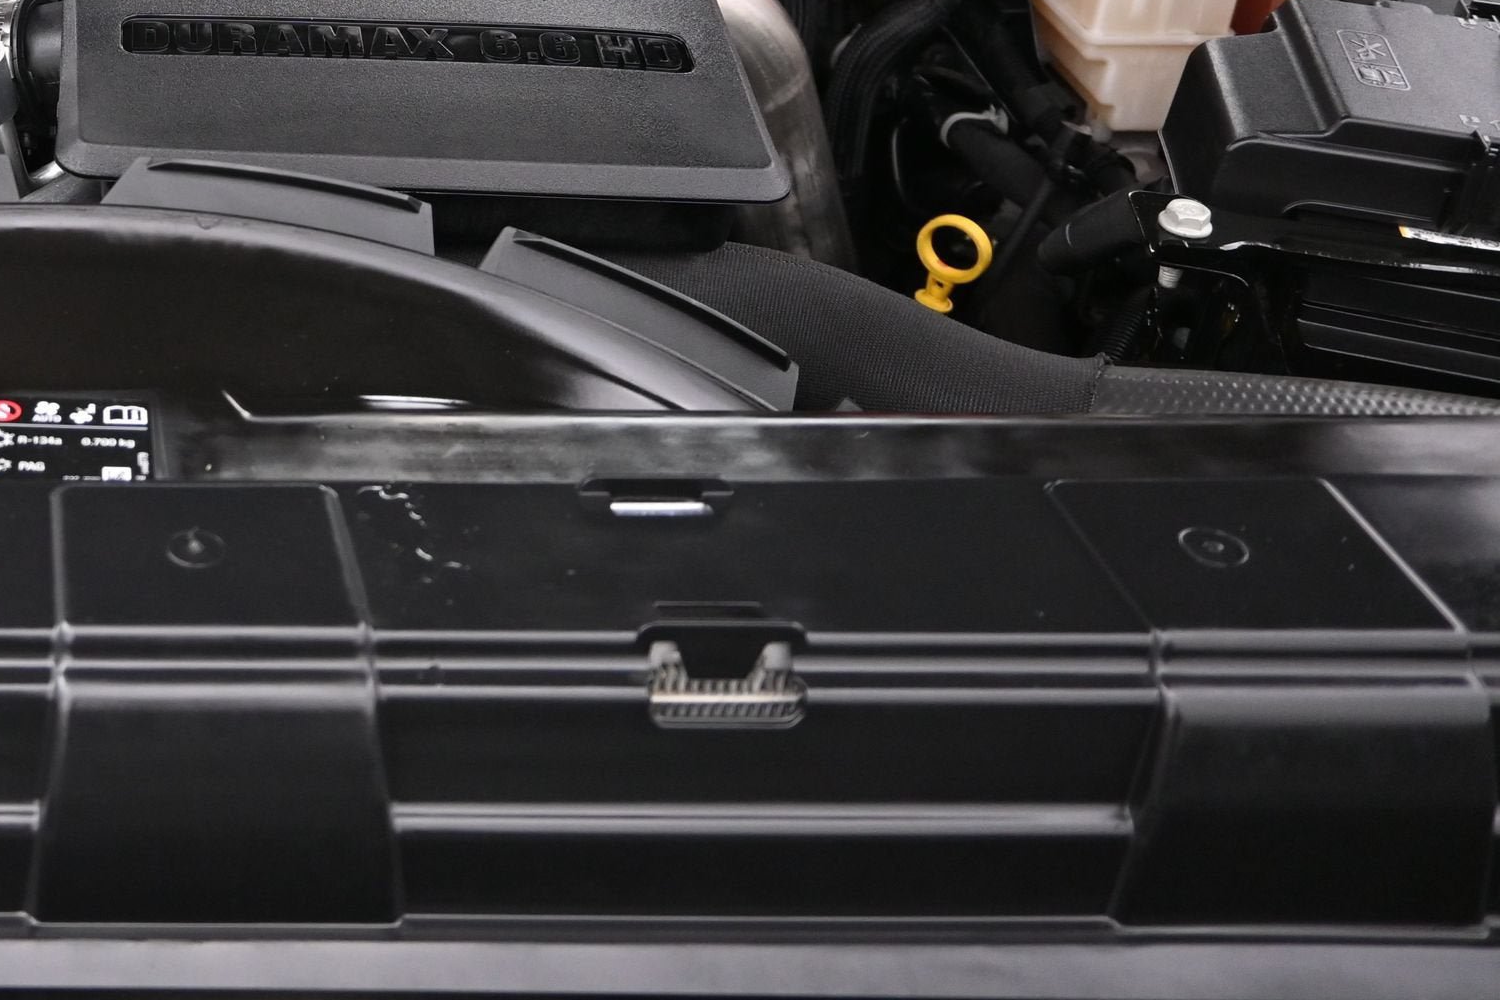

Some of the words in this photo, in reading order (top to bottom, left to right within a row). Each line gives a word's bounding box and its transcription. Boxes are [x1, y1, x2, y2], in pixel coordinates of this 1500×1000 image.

[131, 21, 454, 58] DURAMAX
[479, 30, 580, 64] 6.6
[595, 34, 683, 71] HD
[17, 461, 46, 472] PAG
